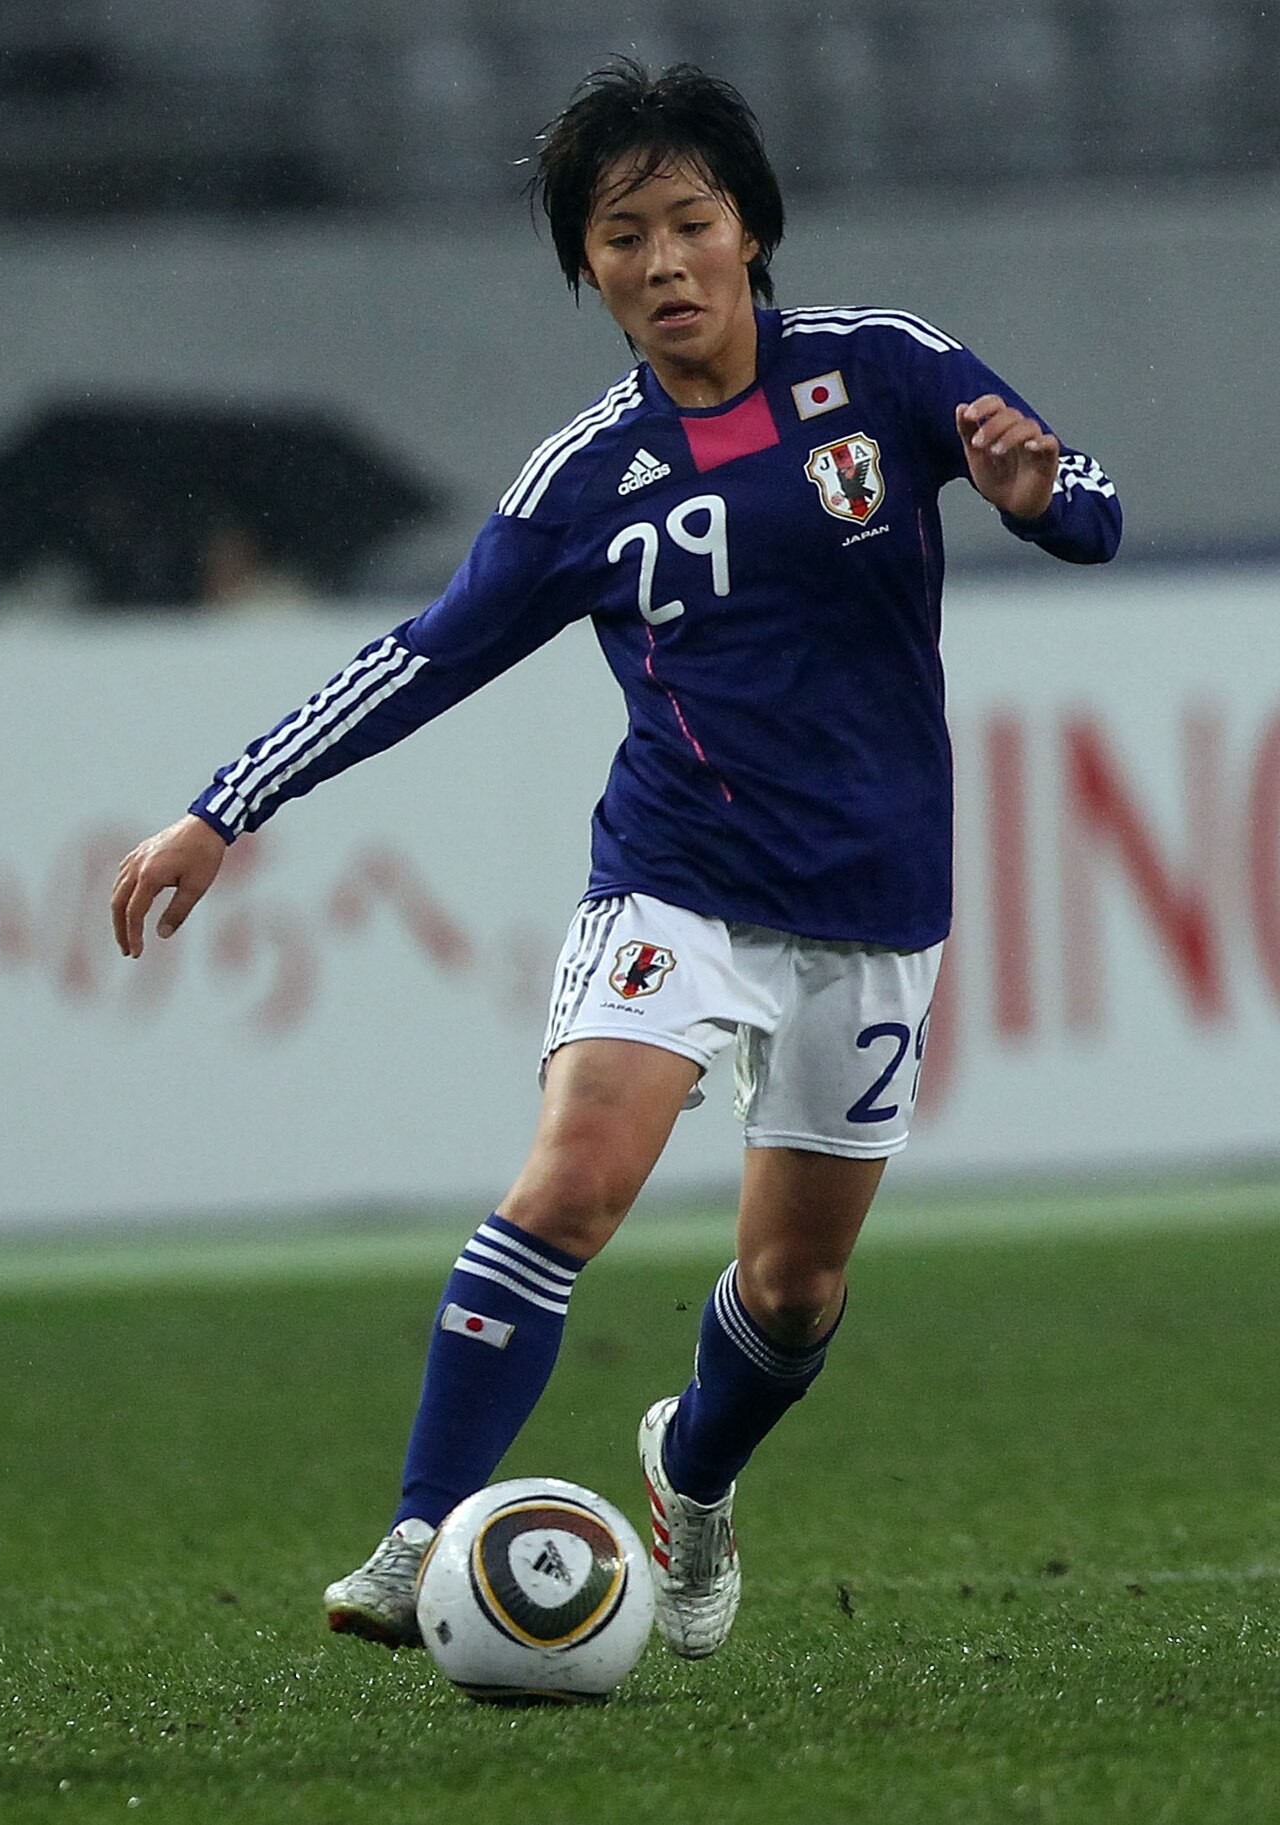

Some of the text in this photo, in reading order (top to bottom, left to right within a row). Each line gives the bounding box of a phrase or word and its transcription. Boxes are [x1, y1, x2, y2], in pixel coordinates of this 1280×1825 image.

[617, 463, 672, 496] adidas
[841, 524, 890, 547] JAPAN
[607, 494, 731, 626] 29
[600, 1002, 645, 1015] JAPAN
